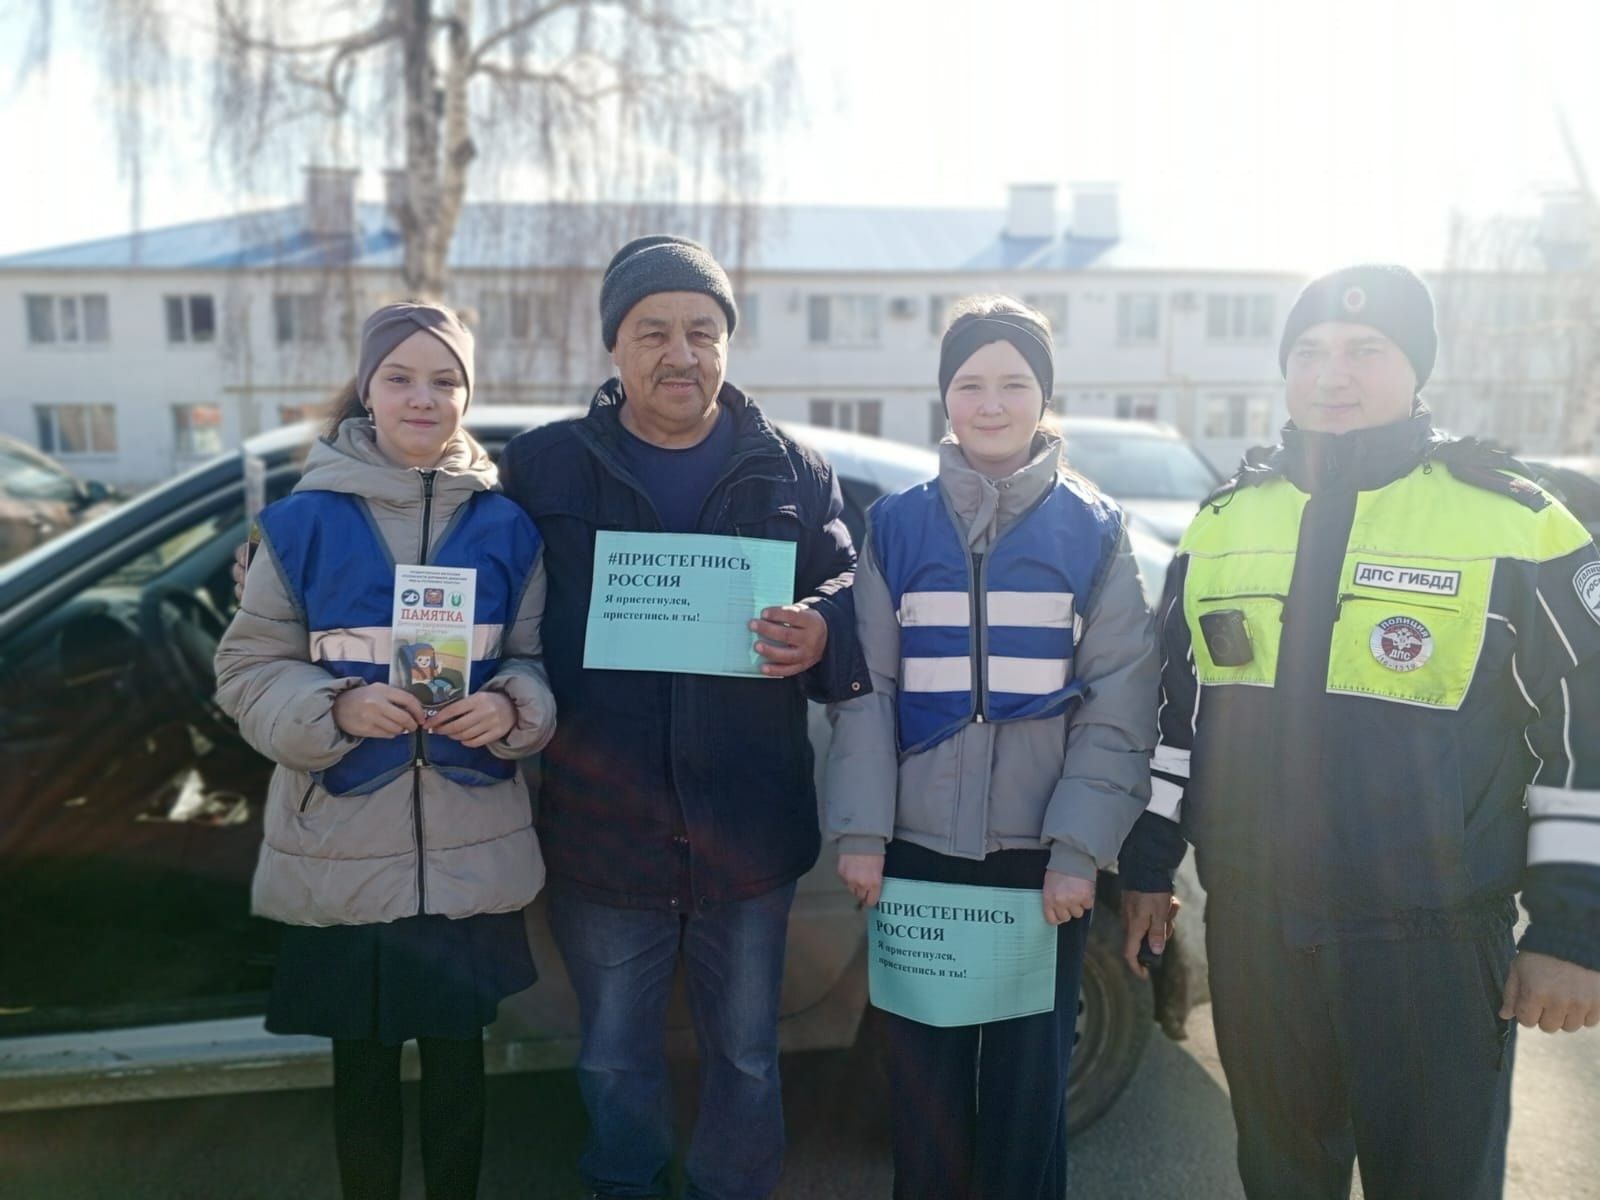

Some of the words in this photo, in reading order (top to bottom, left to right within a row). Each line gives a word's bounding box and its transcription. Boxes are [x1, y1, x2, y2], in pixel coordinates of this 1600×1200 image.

[608, 552, 751, 571] #ПРИСТЕГНИСЬ
[607, 573, 681, 588] РОССИЯ
[1360, 568, 1394, 582] ДПС
[1399, 572, 1454, 590] ГИБДД
[605, 594, 614, 604] Я
[616, 595, 690, 607] пристегнулся,
[400, 608, 464, 622] ПАМЯТКА
[603, 611, 669, 621] пристегнись
[682, 613, 700, 622] ты!
[1381, 617, 1430, 638] ПОЛИЦИЯ
[1389, 649, 1411, 661] ДПС
[876, 919, 945, 941] РОССИЯ
[877, 940, 884, 949] Я
[885, 946, 956, 961] пристегнулся,
[878, 957, 936, 976] пристегнись
[939, 969, 945, 977] и
[949, 969, 967, 978] ты!
